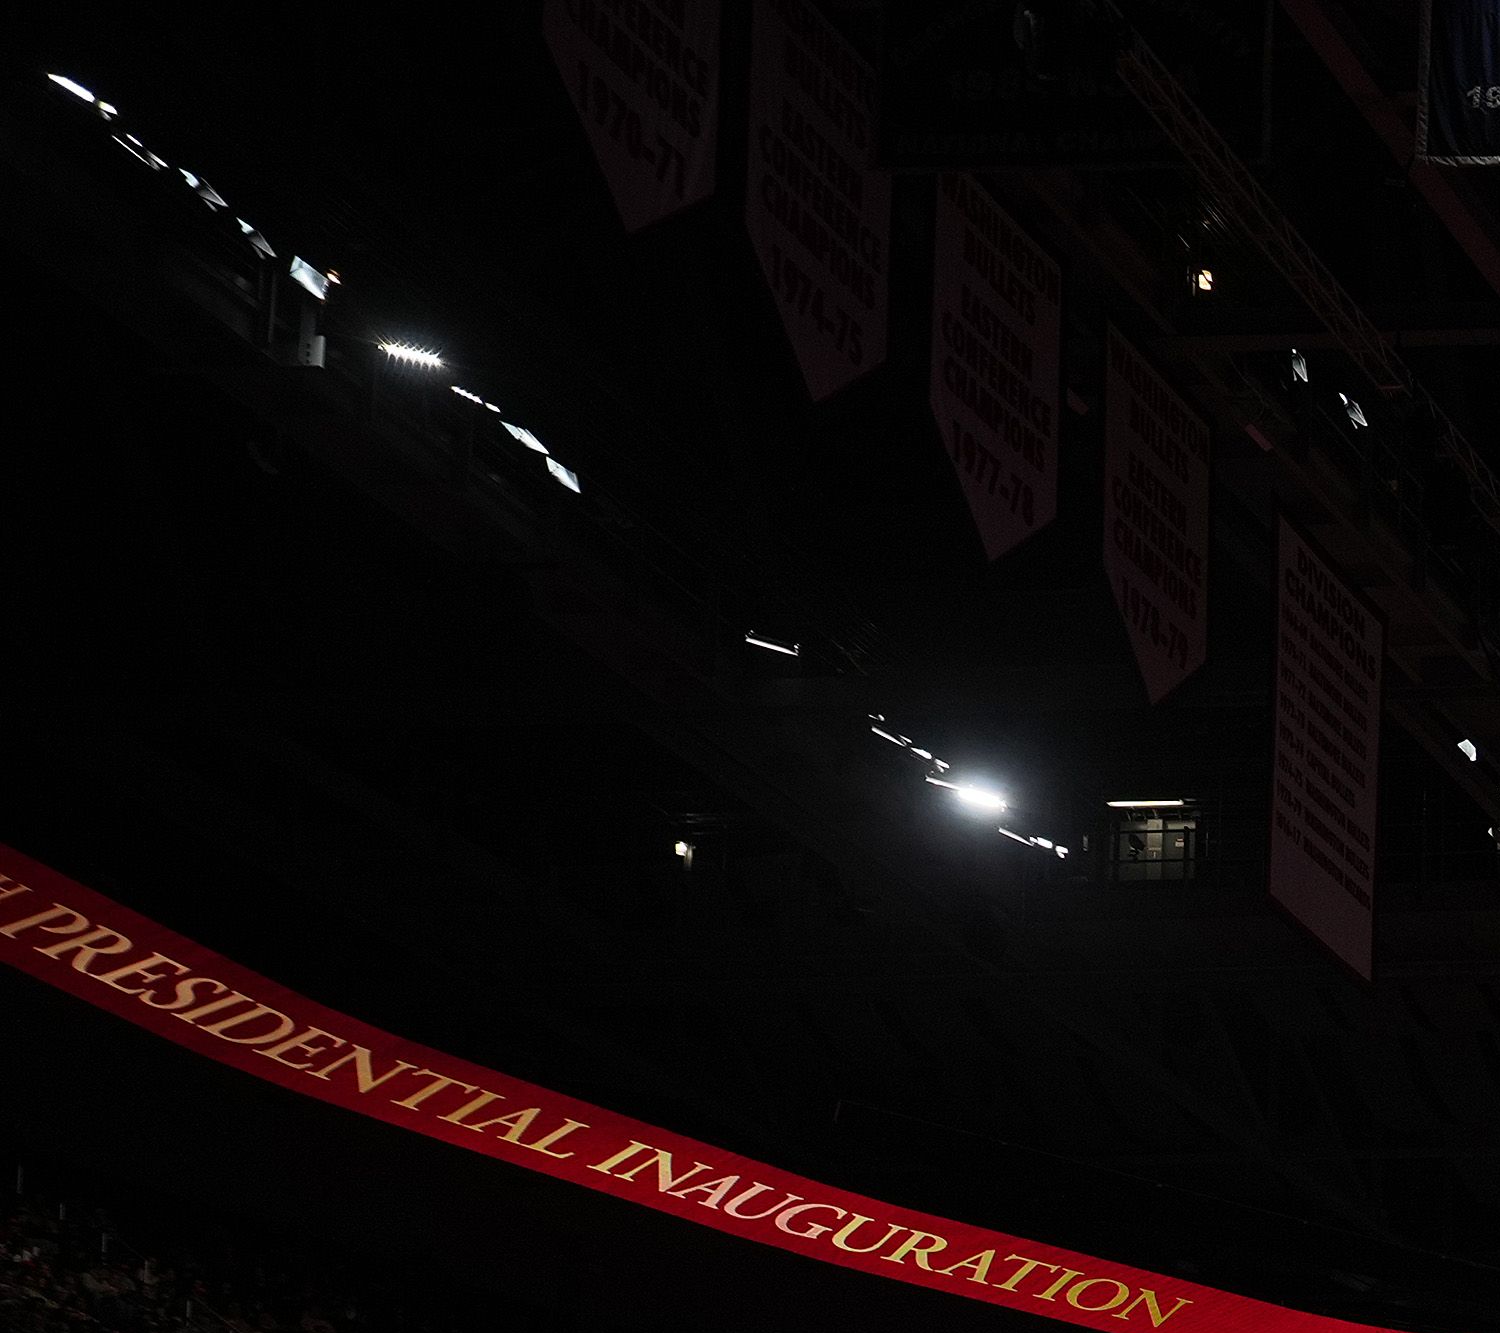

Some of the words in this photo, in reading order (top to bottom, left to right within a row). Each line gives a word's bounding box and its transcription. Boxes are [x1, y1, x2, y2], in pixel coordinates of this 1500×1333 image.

[1285, 568, 1376, 681] CHAMPIONS
[0, 902, 589, 1158] PRESIDENTIAL
[587, 1139, 1193, 1328] INAUGURATION
